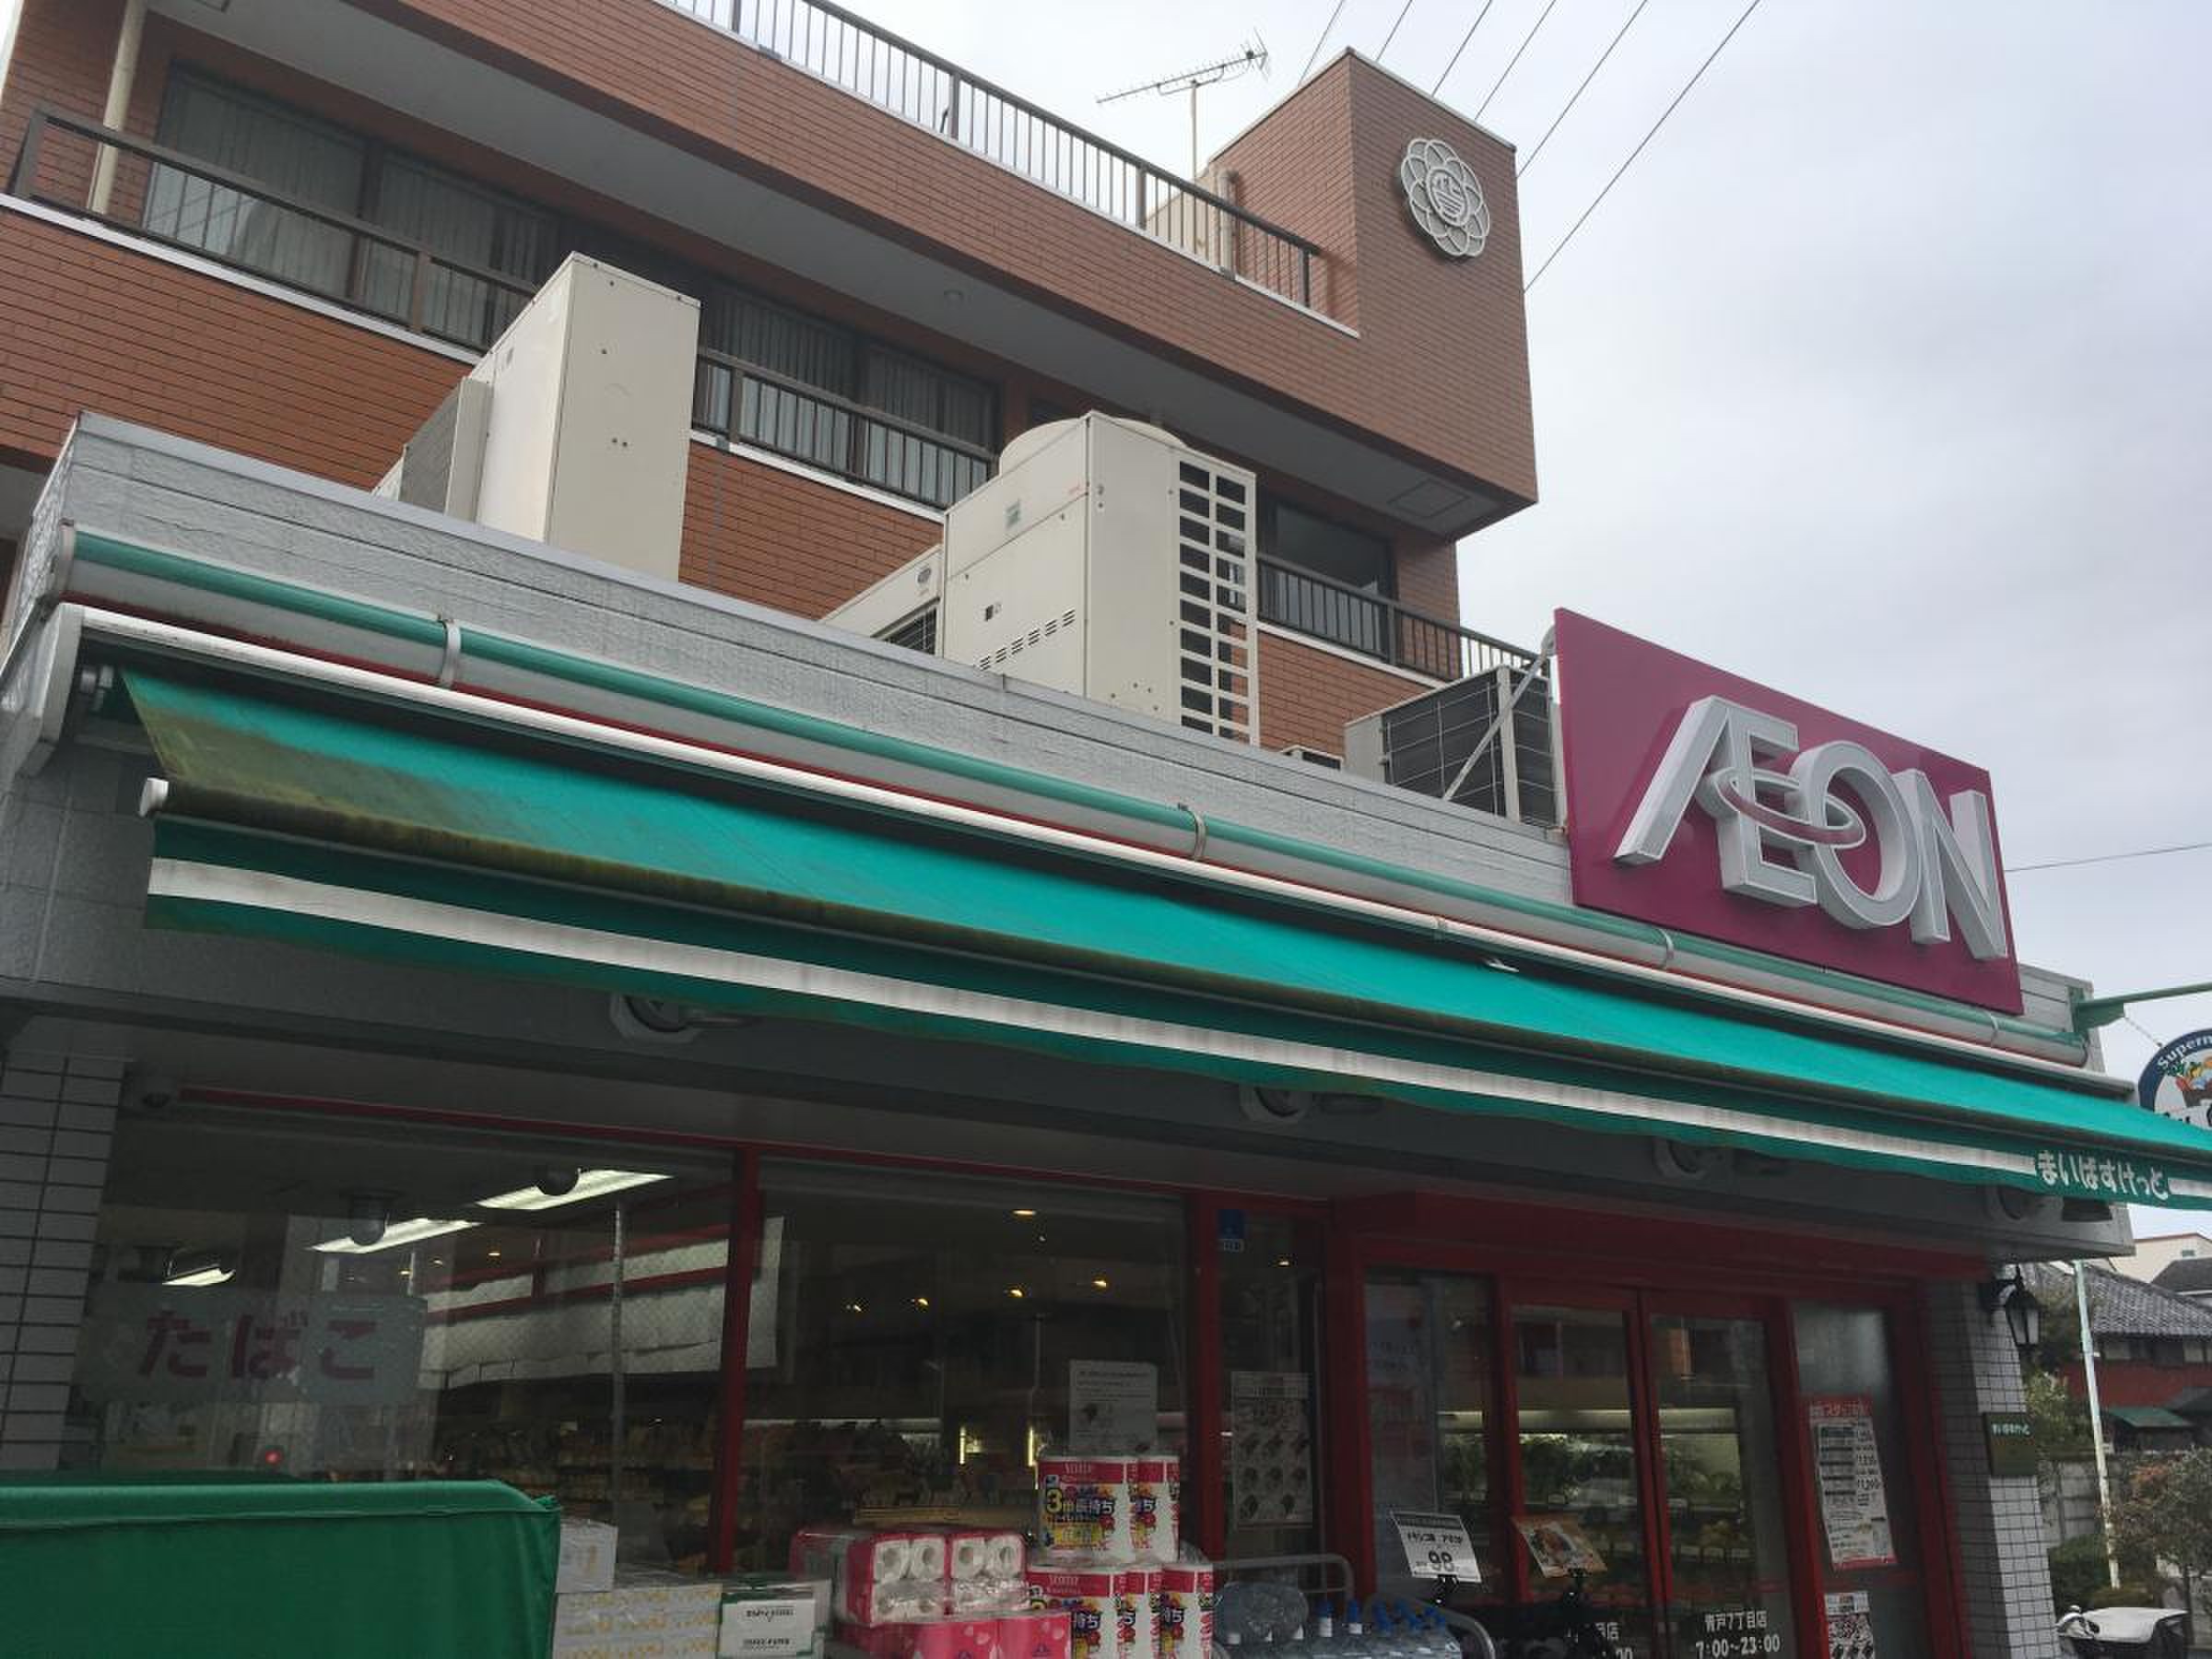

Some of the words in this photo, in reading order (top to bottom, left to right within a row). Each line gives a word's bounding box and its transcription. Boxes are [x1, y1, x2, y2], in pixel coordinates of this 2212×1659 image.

[2034, 1150, 2170, 1200] まいばすけっと
[140, 1309, 377, 1379] たばこ
